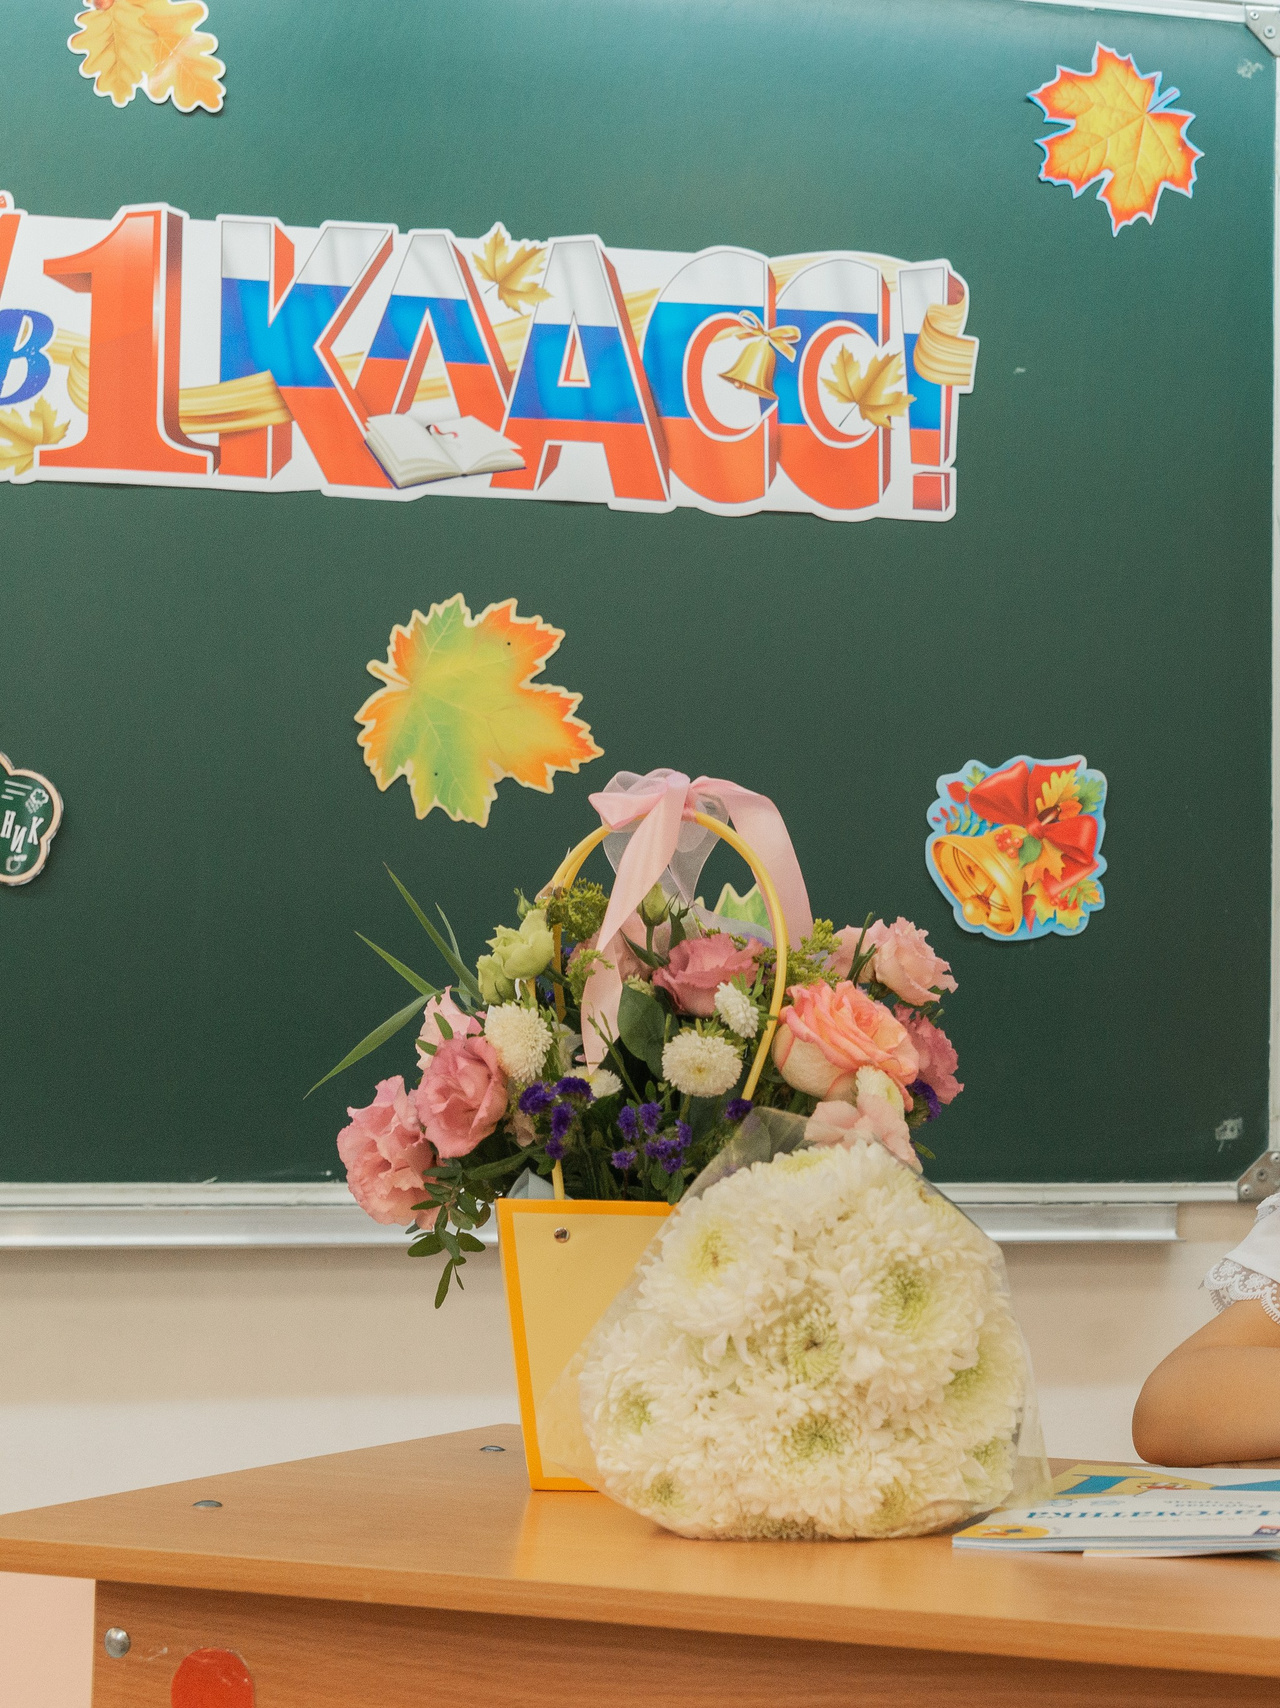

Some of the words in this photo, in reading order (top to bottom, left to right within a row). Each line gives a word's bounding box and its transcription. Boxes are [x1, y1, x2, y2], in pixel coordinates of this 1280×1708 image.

[38, 208, 222, 476] 1
[217, 219, 957, 514] КЛАСС!
[0, 809, 45, 854] НИК
